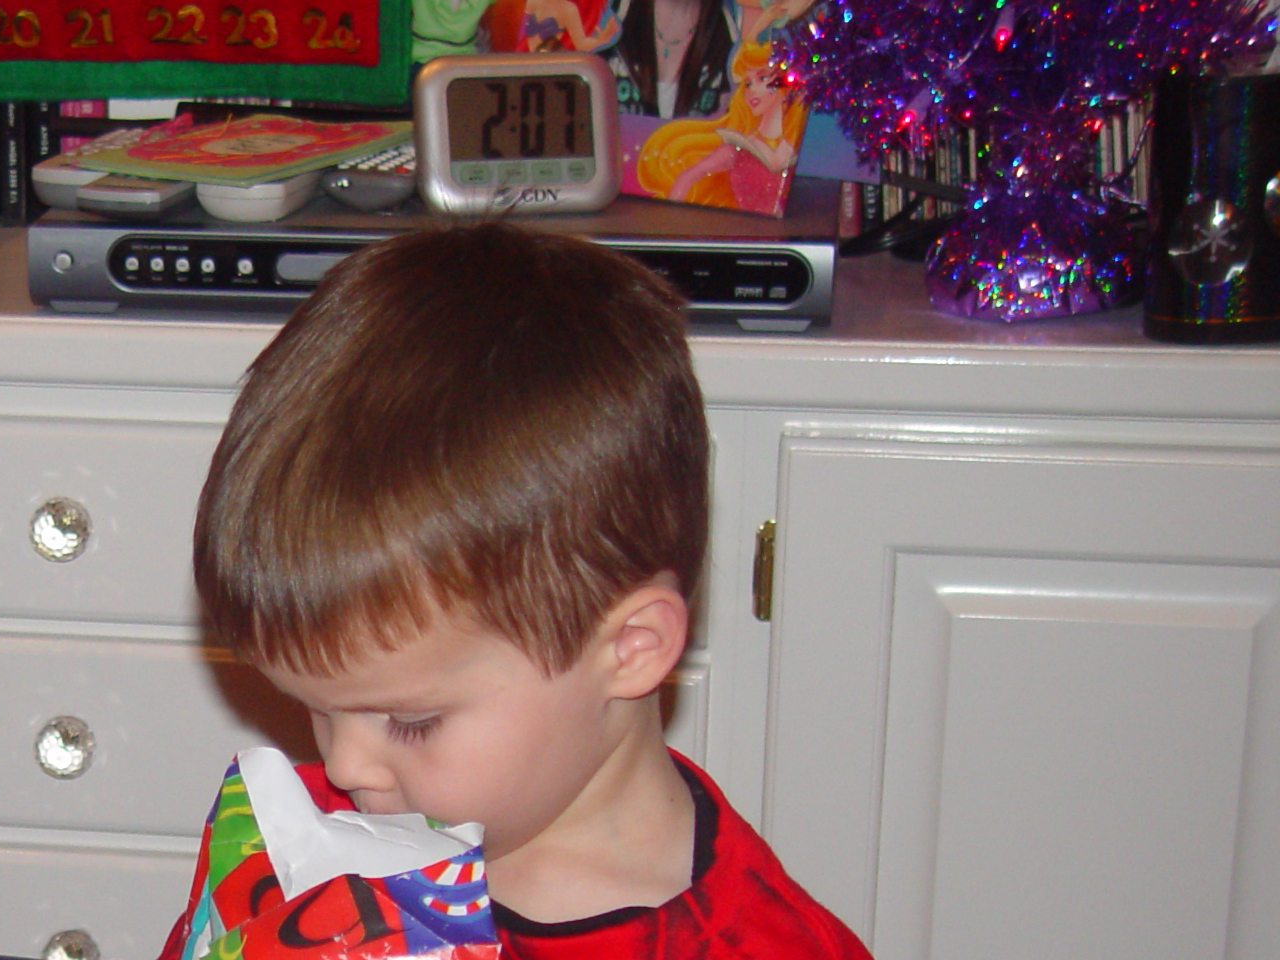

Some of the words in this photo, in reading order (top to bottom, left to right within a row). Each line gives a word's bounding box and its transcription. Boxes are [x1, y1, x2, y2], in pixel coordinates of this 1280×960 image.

[66, 8, 113, 48] 21
[147, 5, 208, 44] 22
[221, 6, 279, 49] 23
[302, 8, 361, 53] 24
[482, 81, 576, 158] 2:07
[521, 188, 561, 202] CDN
